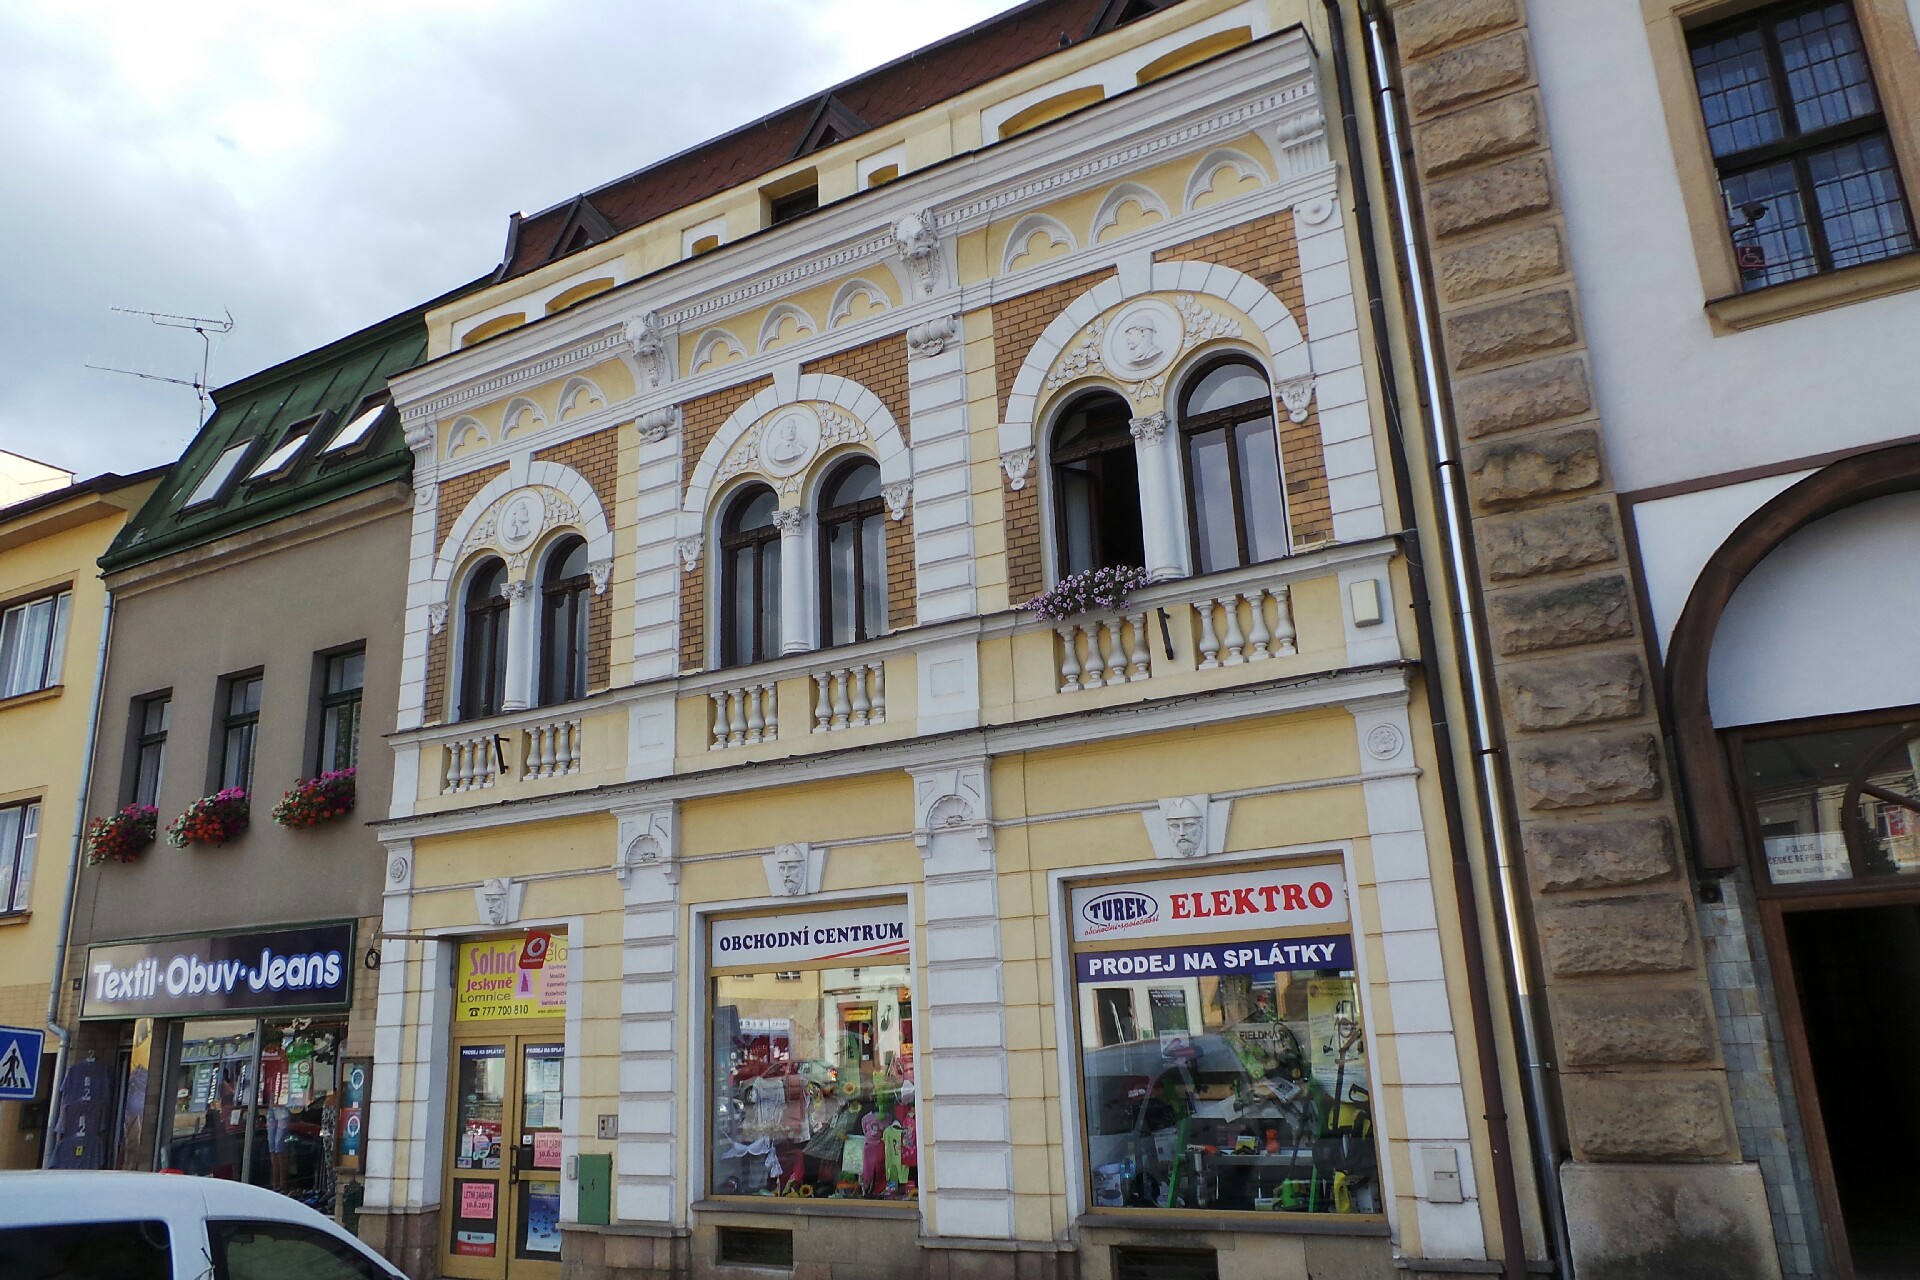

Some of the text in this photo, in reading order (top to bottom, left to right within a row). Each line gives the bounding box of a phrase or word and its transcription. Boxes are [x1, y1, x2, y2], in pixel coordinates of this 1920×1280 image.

[1089, 897, 1148, 921] TUREK
[1169, 881, 1333, 920] ELEKTRO
[719, 922, 904, 951] OBCHODNÍ CENTRUM
[469, 944, 517, 977] Solná
[1089, 943, 1336, 976] PRODEJ NA SPLÁTKY
[93, 949, 341, 1000] Textil Obuv Jeans
[466, 977, 513, 993] Jeskyně
[460, 992, 511, 1003] Lomnice
[482, 1006, 496, 1016] 777
[498, 1006, 512, 1016] 700
[514, 1004, 529, 1015] 810
